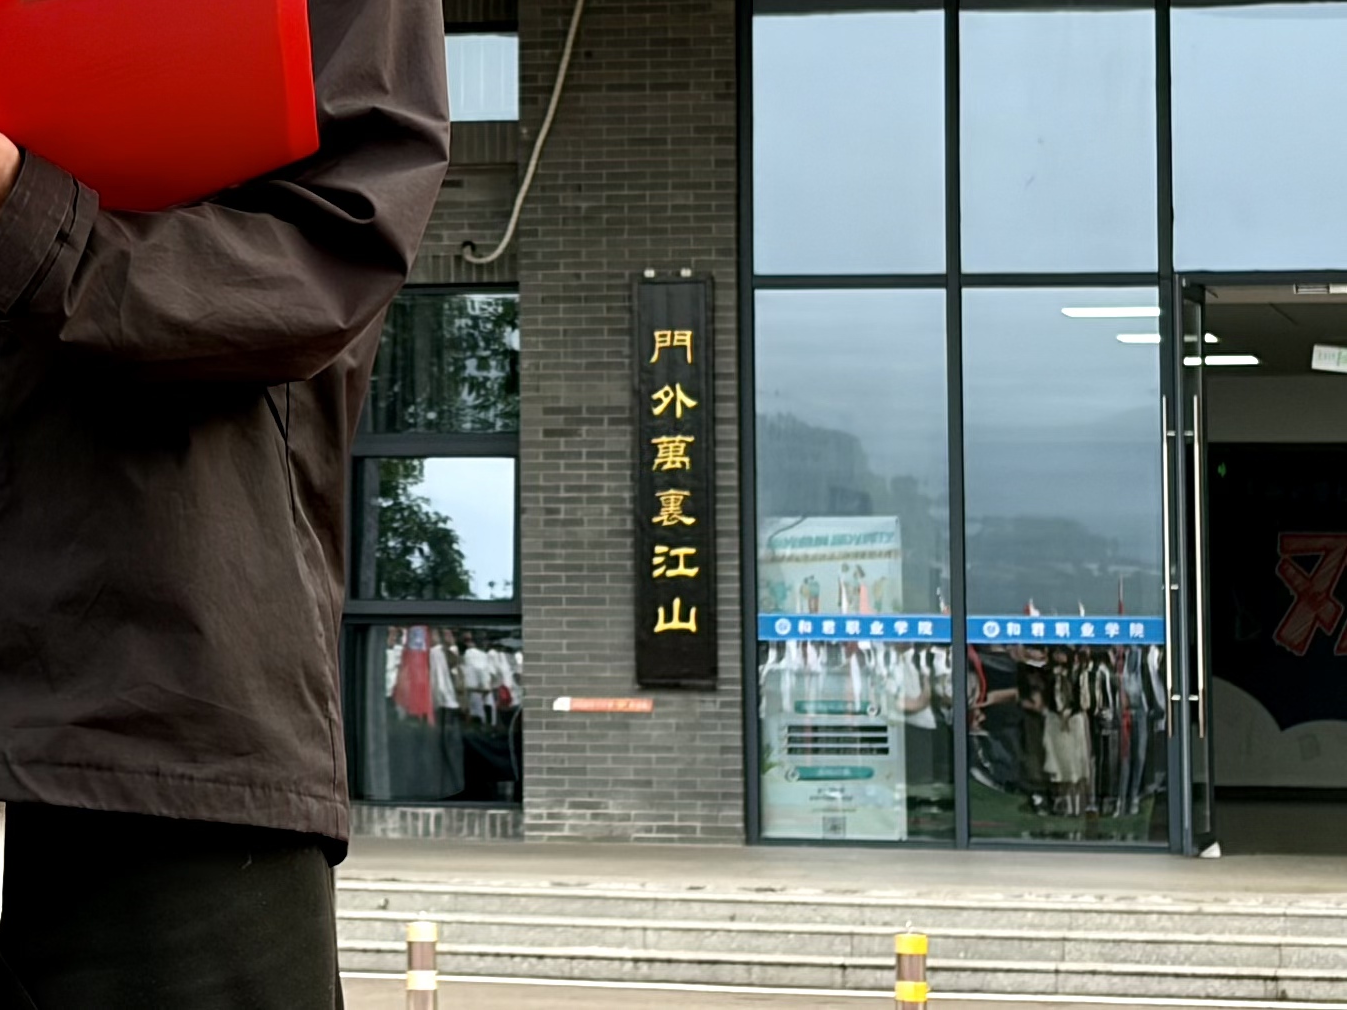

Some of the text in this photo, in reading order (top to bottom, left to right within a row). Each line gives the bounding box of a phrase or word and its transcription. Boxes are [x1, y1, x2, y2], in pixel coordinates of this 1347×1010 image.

[649, 329, 699, 634] 門外萬裏江山
